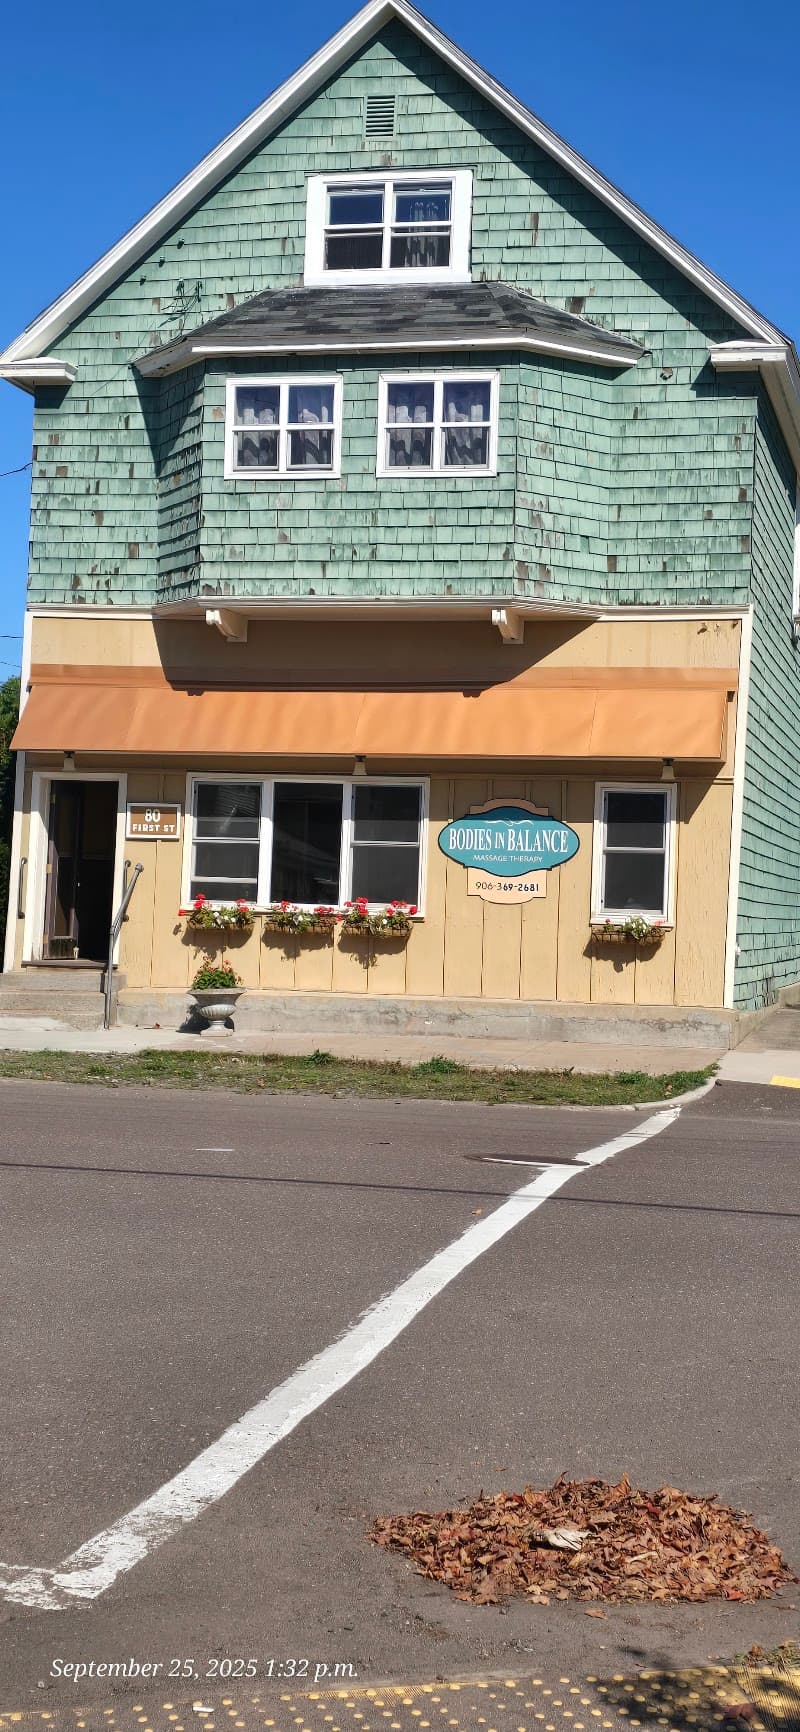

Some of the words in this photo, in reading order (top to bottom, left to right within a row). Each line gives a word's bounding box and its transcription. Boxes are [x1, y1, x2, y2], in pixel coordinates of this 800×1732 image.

[145, 809, 161, 822] 80
[132, 824, 160, 832] FIRST
[449, 828, 492, 851] BODIES
[495, 832, 505, 849] IN
[507, 828, 569, 853] BALANCE
[510, 855, 543, 863] THERAPY
[475, 882, 539, 892] 906-369-2681
